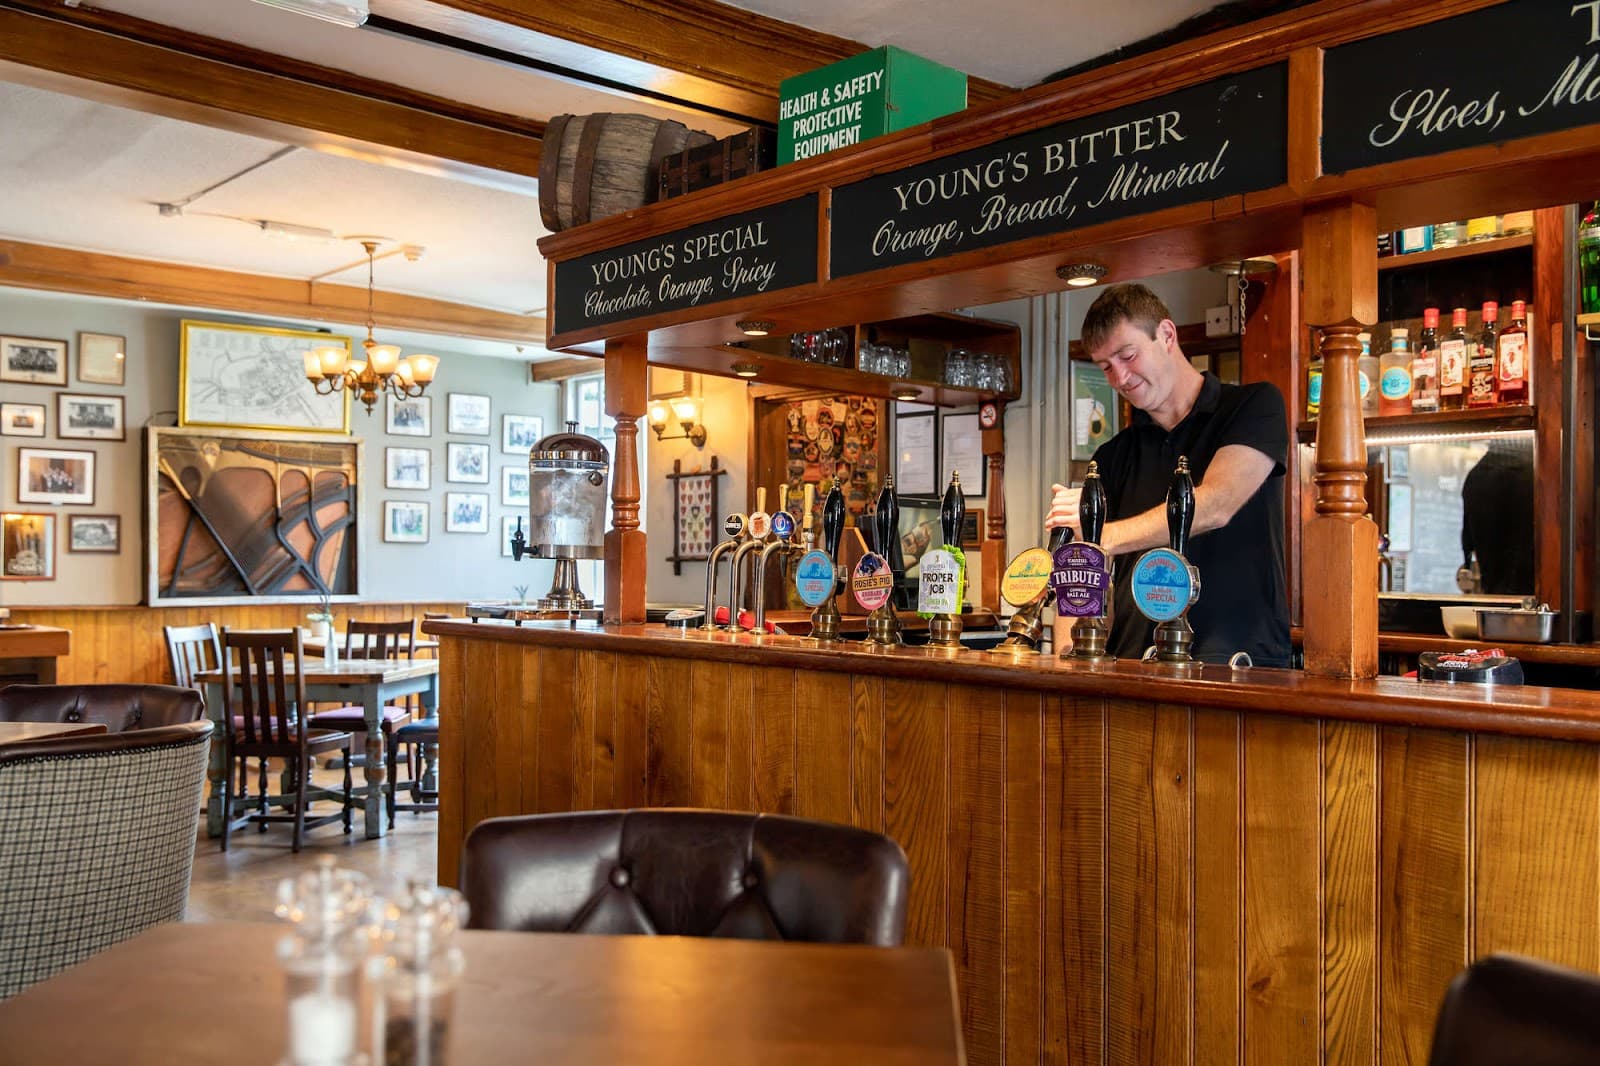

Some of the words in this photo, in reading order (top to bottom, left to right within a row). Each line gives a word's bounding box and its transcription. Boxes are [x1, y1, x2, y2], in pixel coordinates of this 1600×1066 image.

[780, 91, 818, 121] HEALTH
[821, 88, 831, 107] &
[834, 69, 884, 103] SAFETY
[793, 100, 863, 139] PROTECTIVE
[1369, 87, 1506, 147] Sloes,
[794, 124, 862, 161] EQUIPMENT
[893, 151, 1029, 212] YOUNG'S
[1043, 110, 1187, 176] BITTER
[872, 220, 964, 257] Orange,
[971, 176, 1078, 235] Bread,
[1087, 139, 1229, 208] Mineral
[592, 244, 675, 285] YOUNG'S
[683, 221, 769, 264] SPECIAL
[584, 283, 652, 318] Chocolate,
[658, 273, 714, 305] Orange,
[722, 256, 777, 292] Spicy
[854, 577, 878, 588] ROSIE'S
[922, 572, 954, 583] PROPER
[929, 584, 945, 596] JOB
[1053, 570, 1101, 585] TRIBUTE
[1145, 592, 1177, 603] SPECIAL
